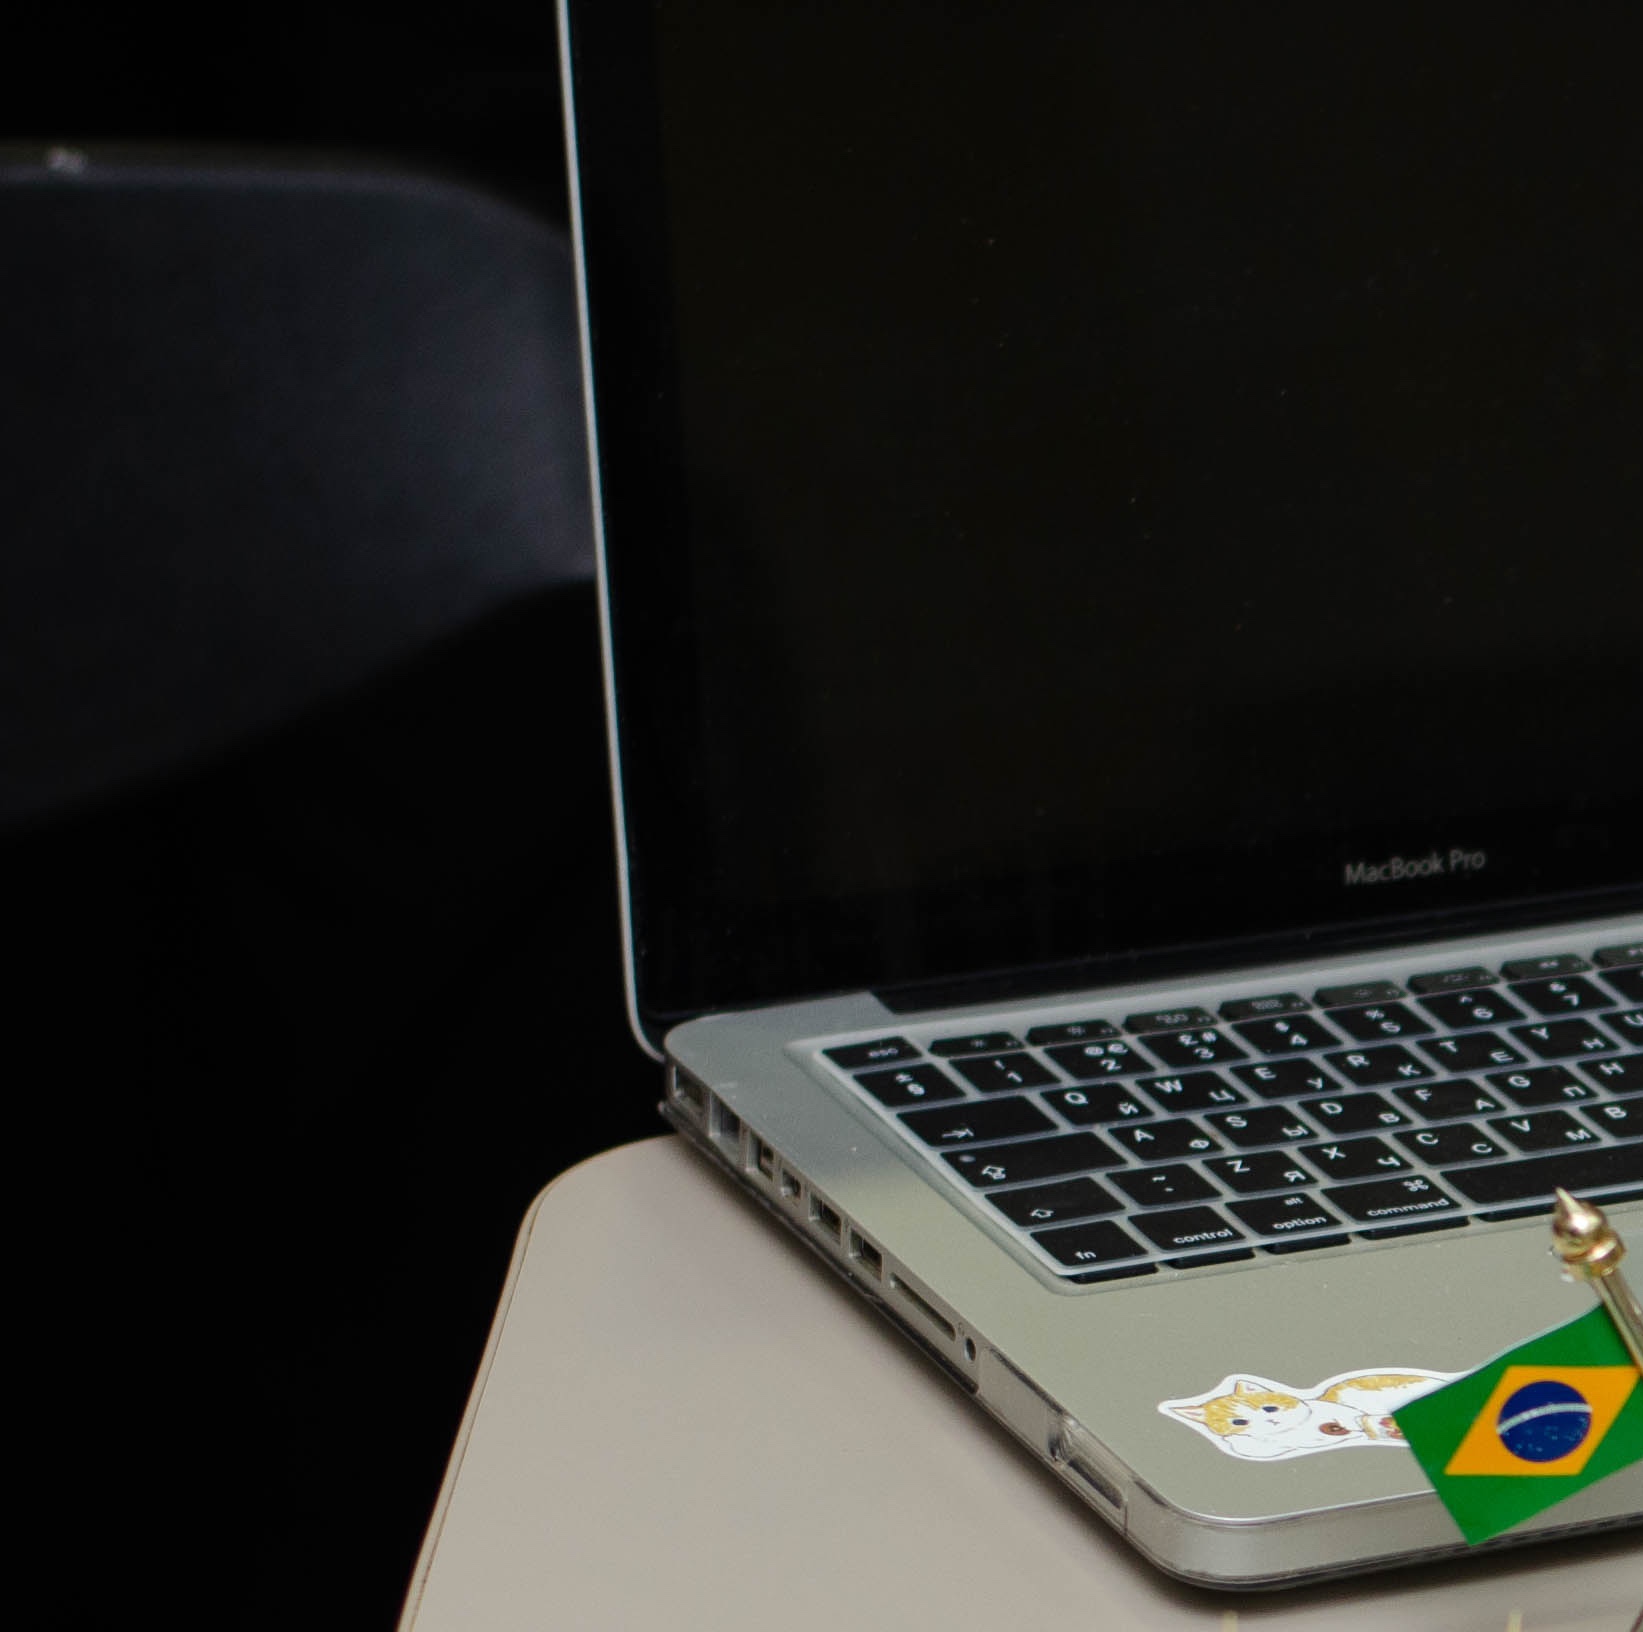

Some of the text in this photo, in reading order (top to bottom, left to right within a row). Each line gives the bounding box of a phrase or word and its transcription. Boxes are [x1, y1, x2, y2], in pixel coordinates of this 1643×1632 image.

[1344, 848, 1486, 885] MacBook Pro
[1564, 994, 1578, 1005] 7
[1473, 1008, 1493, 1018] 6
[1381, 1022, 1400, 1032] 5
[1531, 1028, 1548, 1039] Y
[1440, 1041, 1456, 1052] T
[1195, 1048, 1214, 1058] 3
[1101, 1060, 1120, 1070] 2
[1347, 1055, 1369, 1066] R
[1255, 1068, 1275, 1079] E
[1600, 1063, 1624, 1074] H
[1008, 1072, 1022, 1082] 1
[1508, 1076, 1530, 1087] G
[1155, 1080, 1182, 1092] W
[1064, 1092, 1088, 1104] Q
[1415, 1089, 1431, 1100] F
[1320, 1103, 1342, 1114] D
[1604, 1107, 1626, 1118] B
[1226, 1116, 1247, 1127] S
[1511, 1120, 1530, 1131] V
[1134, 1129, 1154, 1141] A
[1416, 1133, 1438, 1144] C
[1322, 1147, 1345, 1159] X
[1227, 1160, 1250, 1172] Z
[1284, 1170, 1306, 1182] Я
[1366, 1198, 1450, 1217] command
[1273, 1217, 1326, 1229] option
[1173, 1229, 1232, 1243] control
[1074, 1250, 1097, 1260] fn
